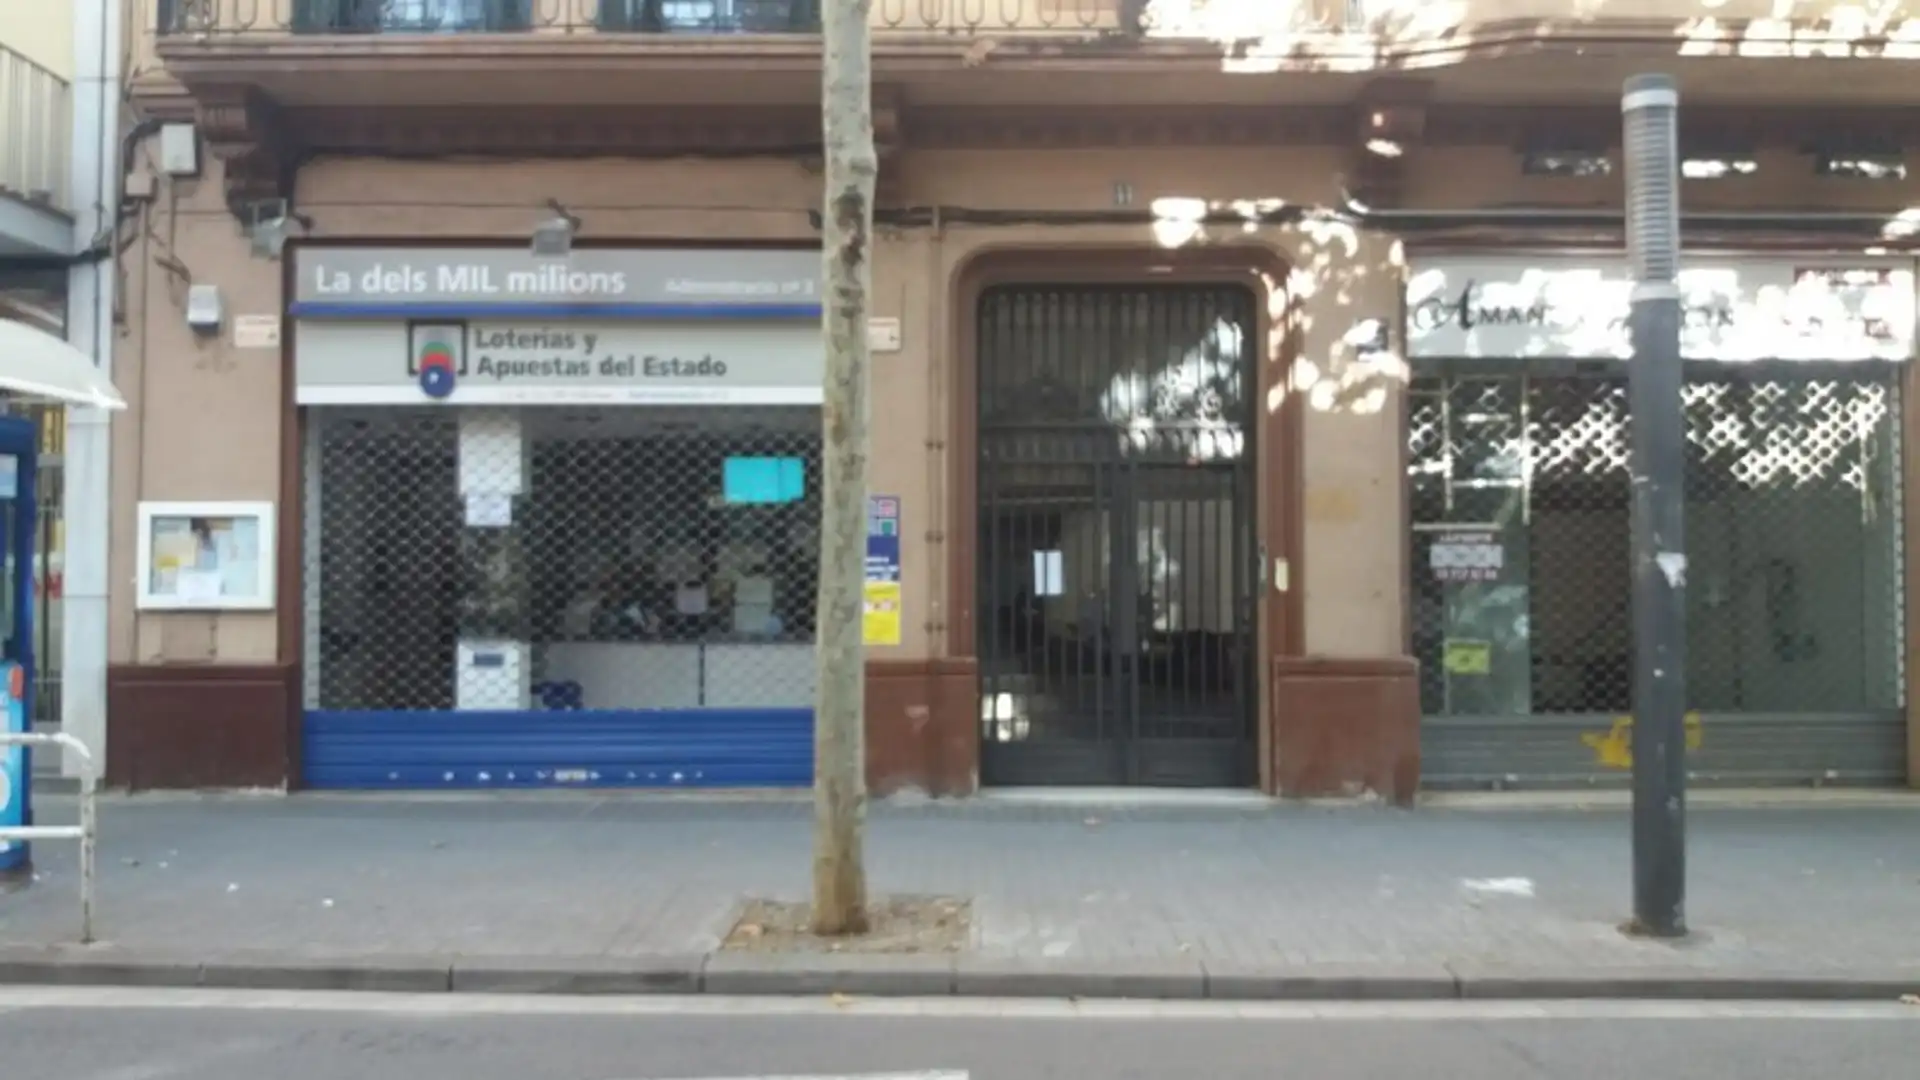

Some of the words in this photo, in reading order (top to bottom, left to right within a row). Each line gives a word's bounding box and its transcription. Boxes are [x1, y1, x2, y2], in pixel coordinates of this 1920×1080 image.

[316, 265, 352, 293] La
[361, 264, 427, 293] dels
[437, 265, 499, 293] MIL
[507, 263, 627, 294] milions
[582, 333, 598, 355] y
[477, 355, 590, 380] Apuestas
[598, 355, 636, 377] del
[642, 354, 728, 377] Estado
